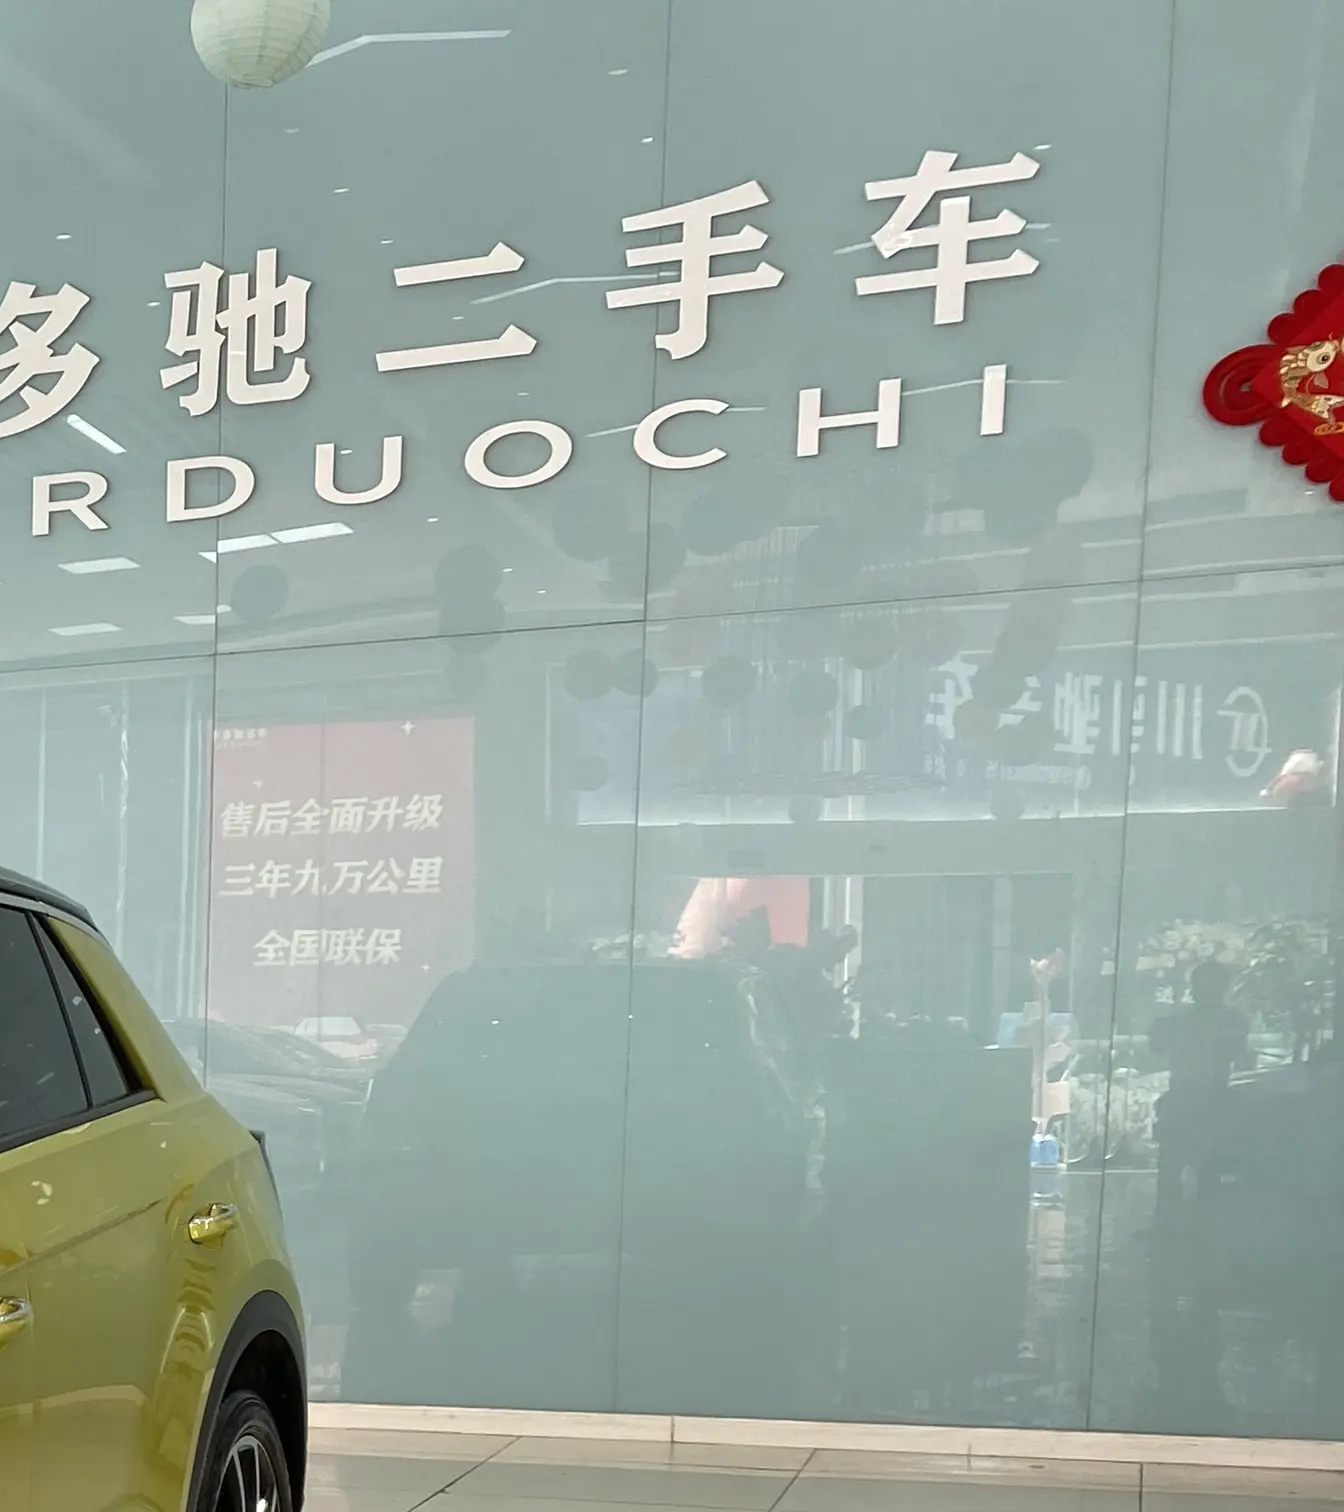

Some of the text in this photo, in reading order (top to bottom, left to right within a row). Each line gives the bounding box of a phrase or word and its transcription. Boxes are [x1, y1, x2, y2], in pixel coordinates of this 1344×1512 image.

[219, 794, 444, 838] 售后全面升级
[218, 856, 443, 898] 三年九万公里
[253, 928, 402, 966] 全国联保
